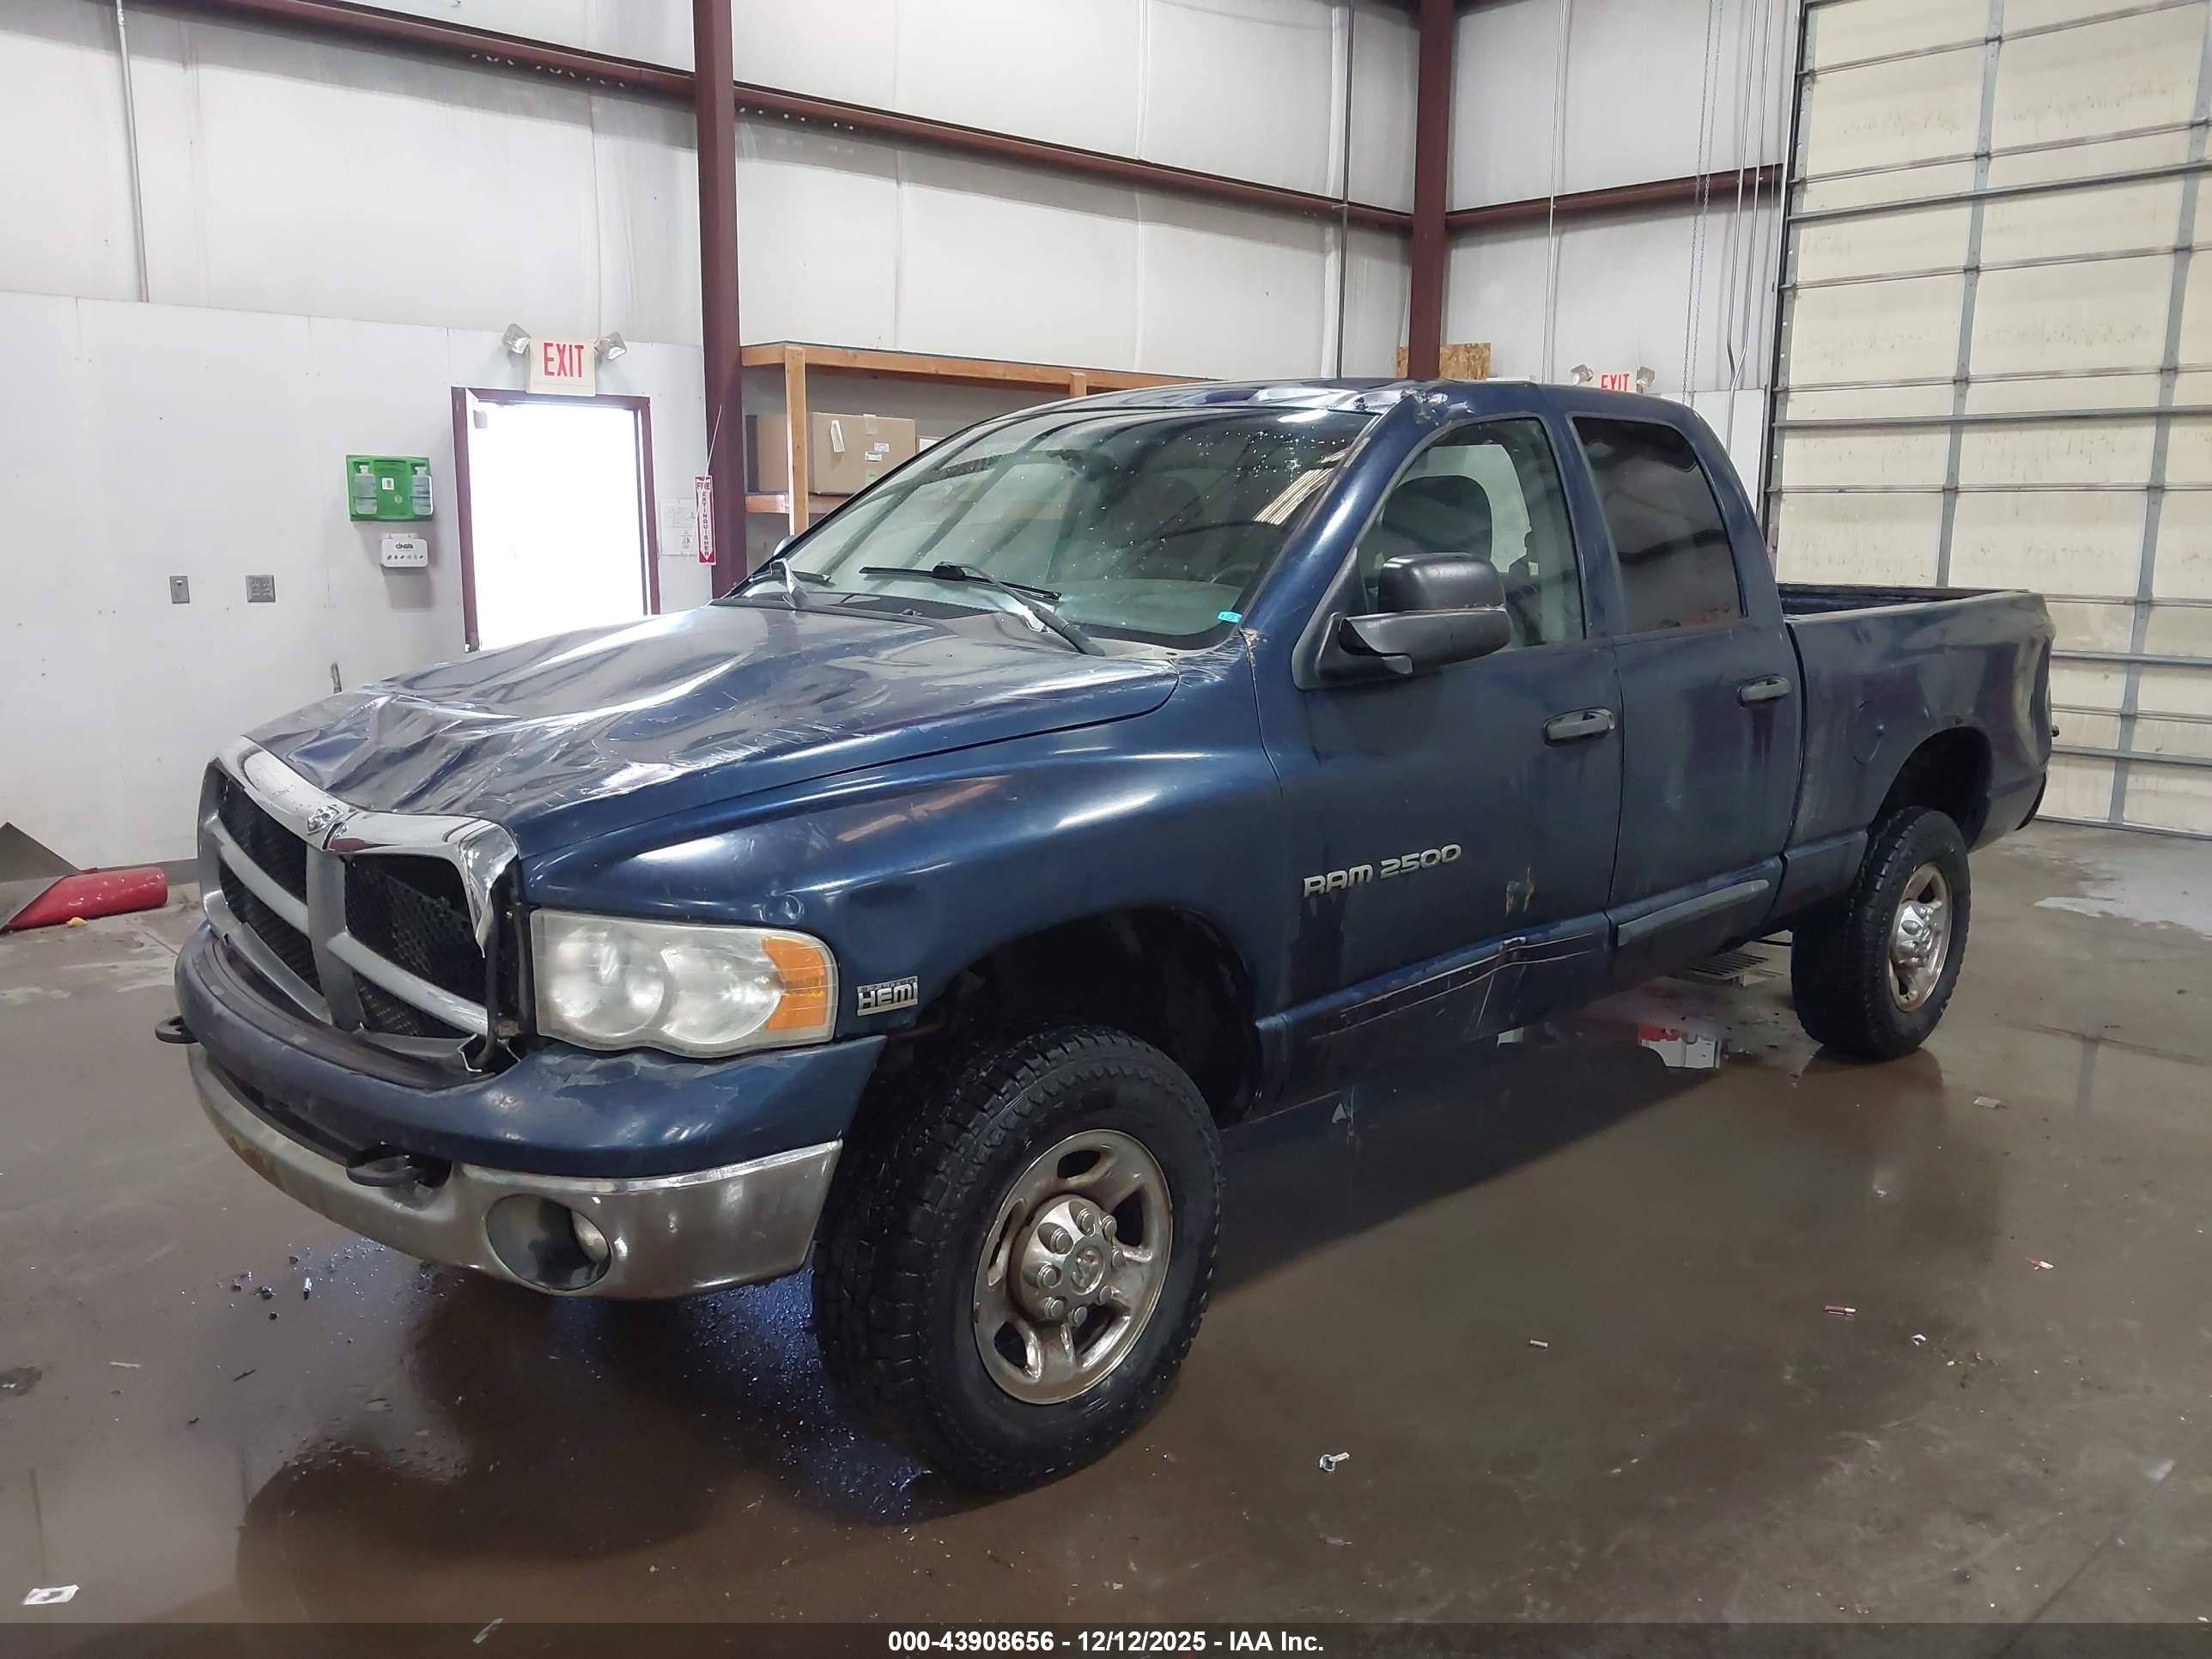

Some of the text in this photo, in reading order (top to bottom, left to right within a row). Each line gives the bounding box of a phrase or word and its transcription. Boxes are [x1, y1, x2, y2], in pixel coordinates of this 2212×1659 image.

[544, 343, 584, 378] EXIT
[1601, 374, 1630, 392] EXIT
[1304, 843, 1462, 898] RAM 2500
[858, 981, 918, 1011] HEMI
